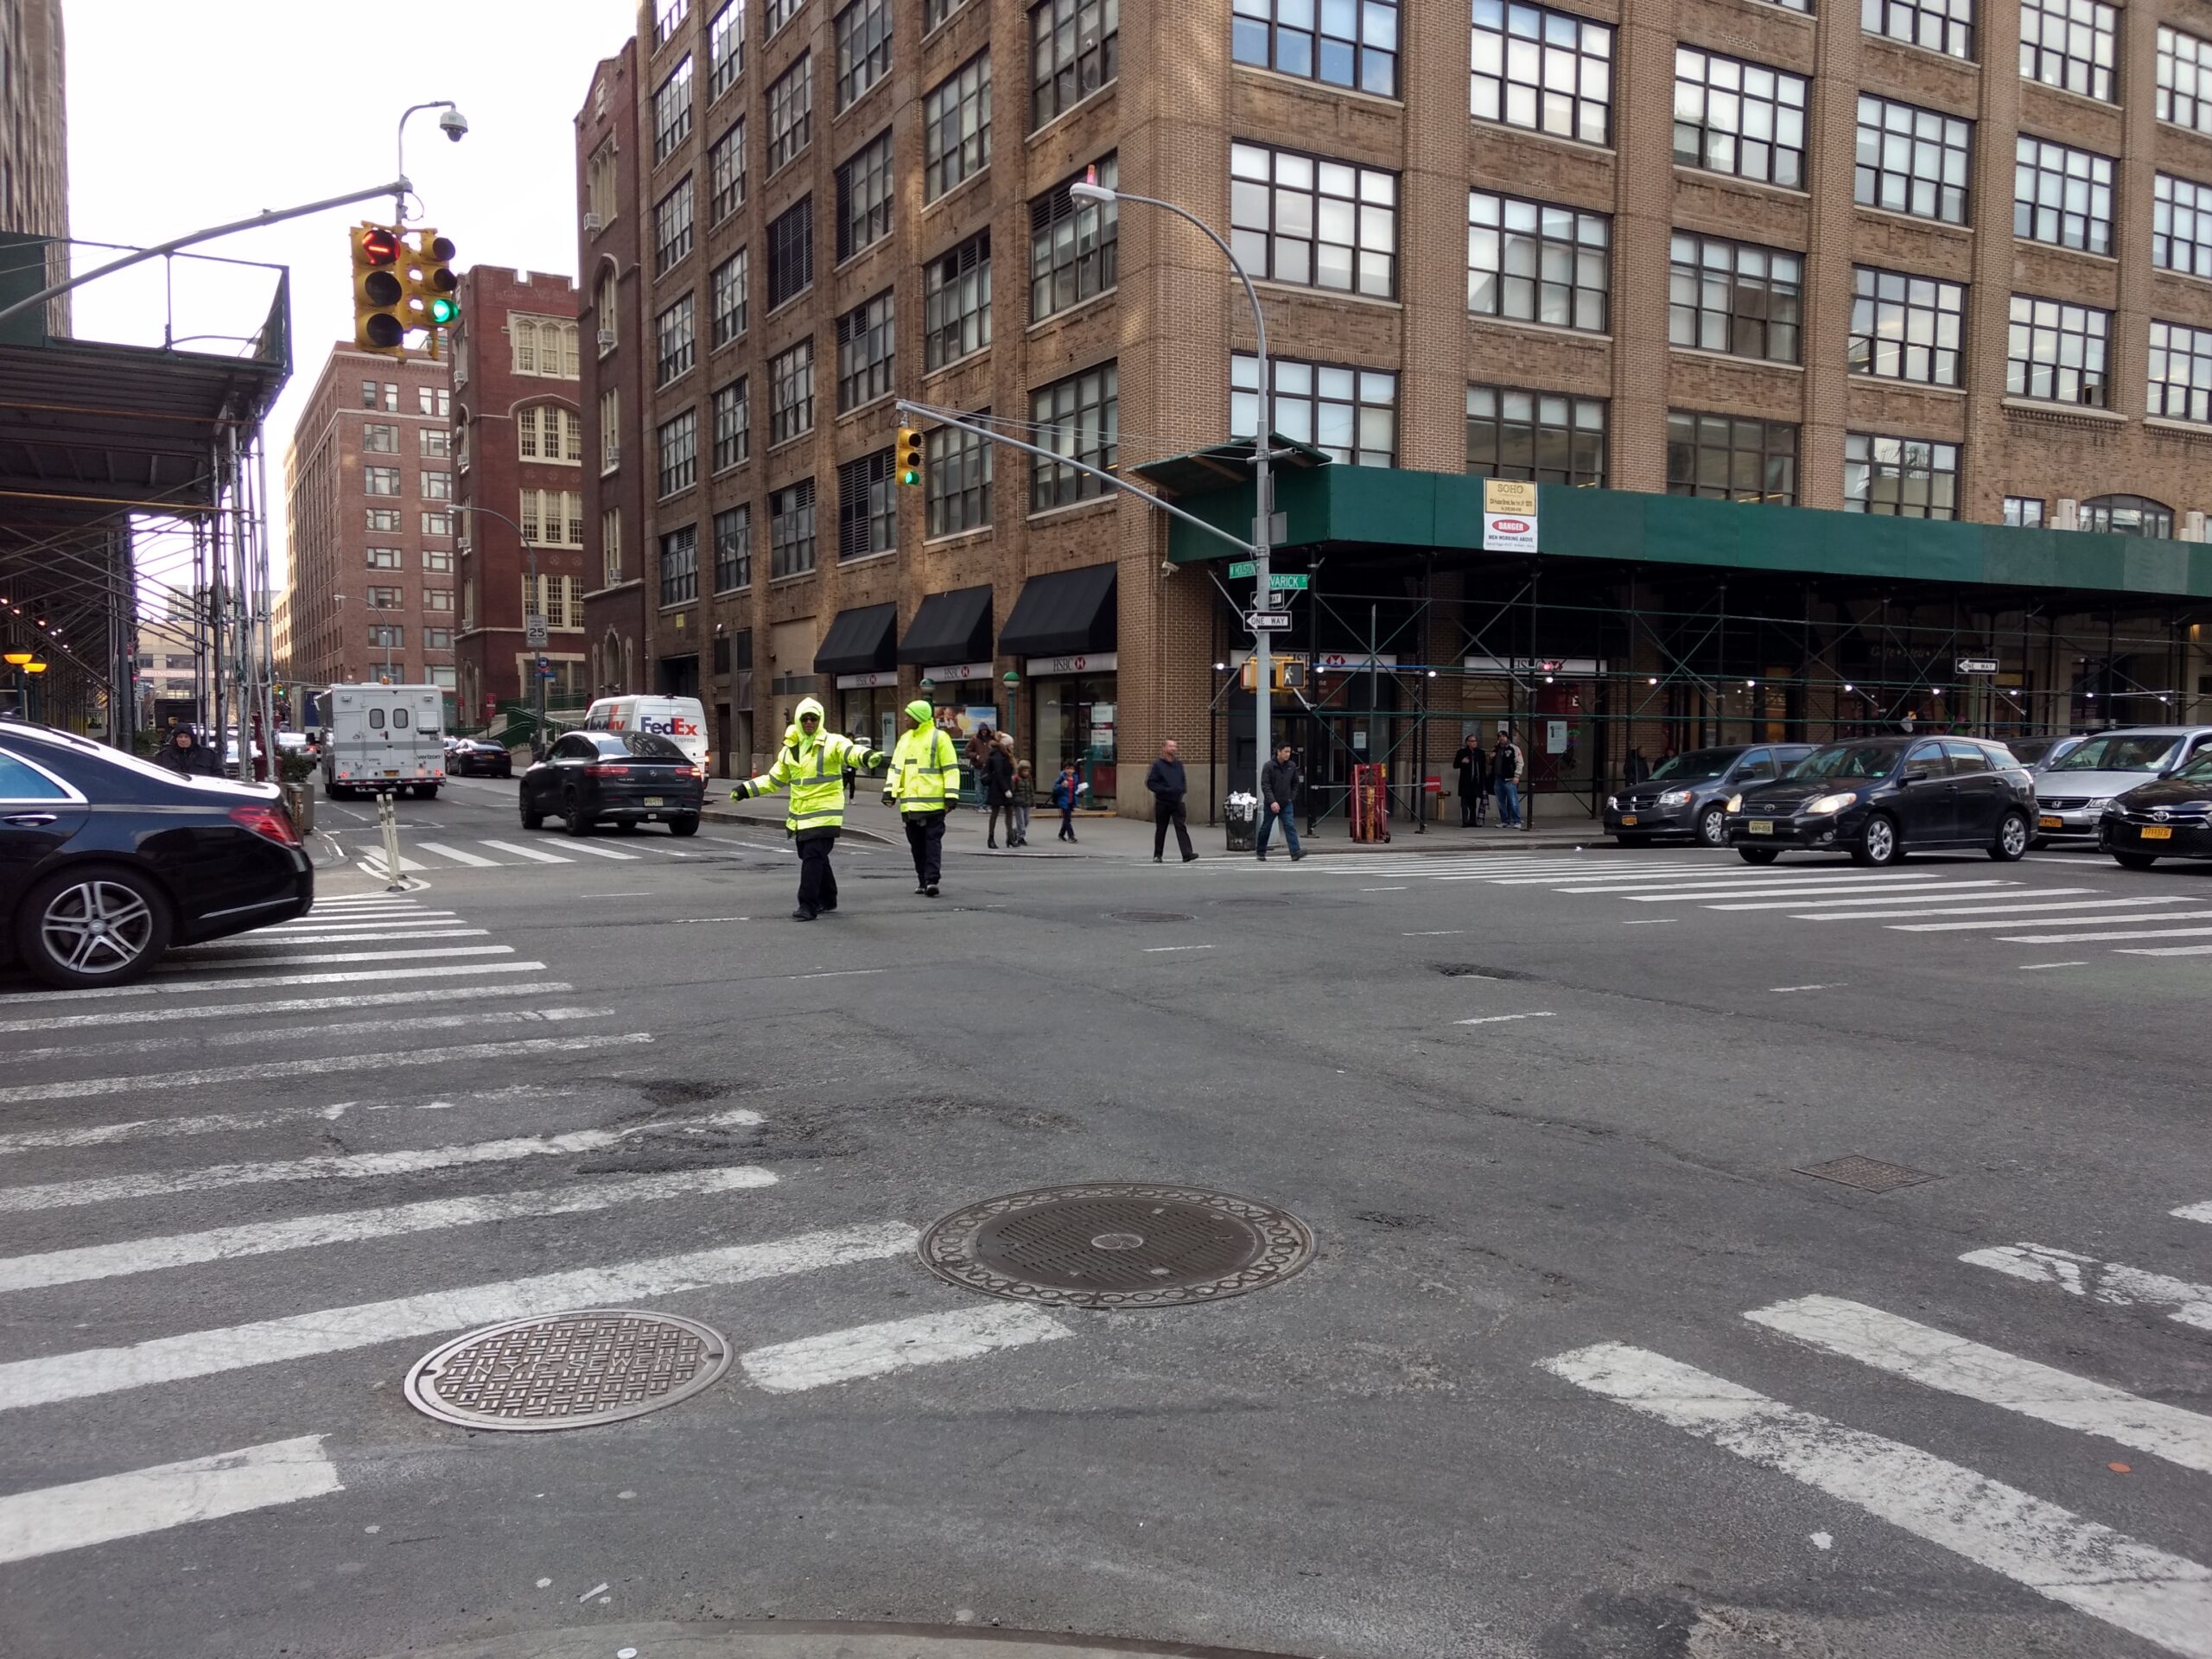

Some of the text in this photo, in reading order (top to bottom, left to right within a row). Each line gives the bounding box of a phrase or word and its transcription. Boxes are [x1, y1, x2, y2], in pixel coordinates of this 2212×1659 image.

[1497, 484, 1523, 493] SOHO
[1498, 522, 1523, 531] DANGER
[1235, 563, 1255, 575] HOUSTON
[1269, 576, 1299, 587] VARICK
[529, 627, 545, 637] 25
[1052, 657, 1073, 672] HSBC
[944, 665, 960, 679] HSBC
[856, 674, 870, 686] HSBC
[641, 716, 698, 735] FedEx
[568, 1354, 675, 1370] SEWER
